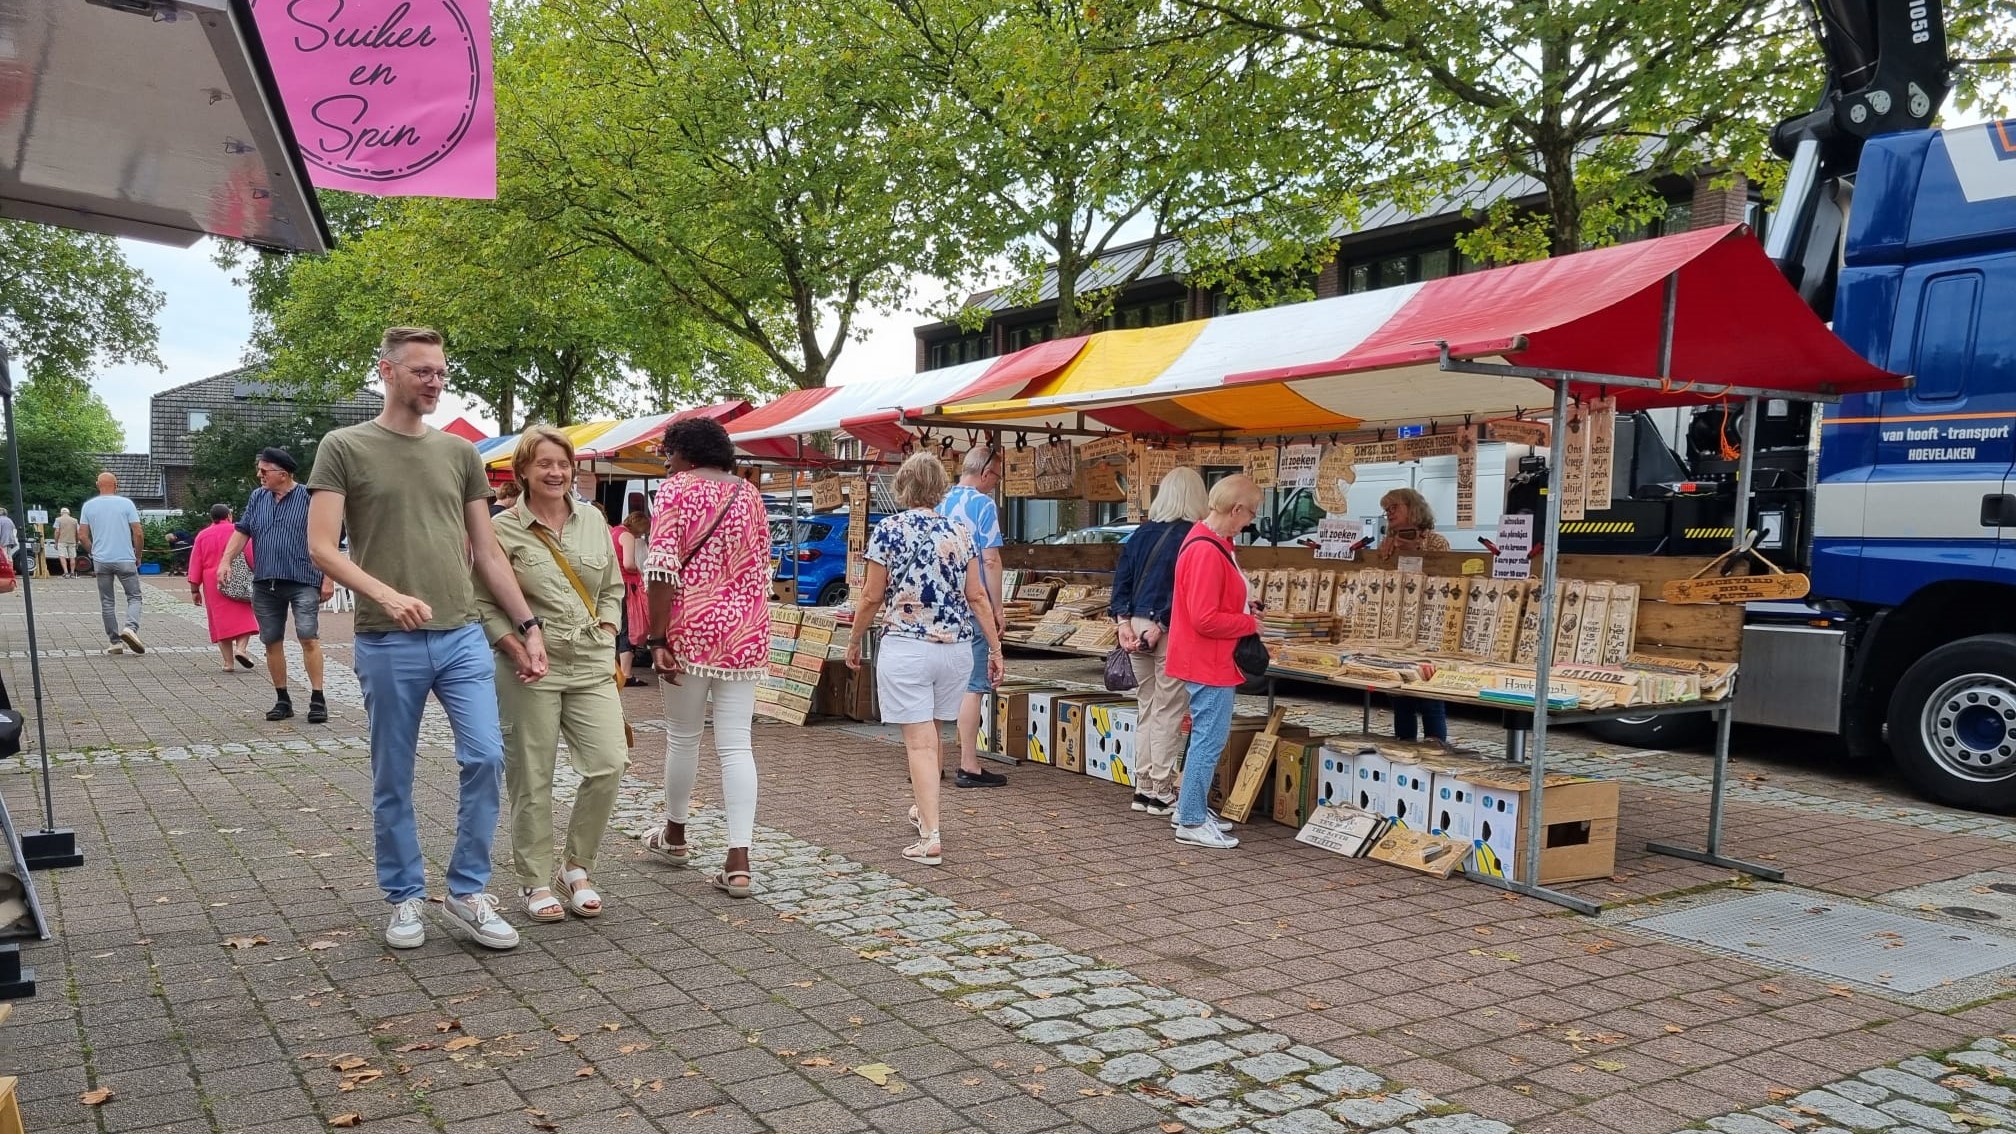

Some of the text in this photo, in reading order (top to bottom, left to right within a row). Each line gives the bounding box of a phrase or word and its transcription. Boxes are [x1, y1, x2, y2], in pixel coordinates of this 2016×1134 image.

[287, 0, 436, 52] Suiker
[349, 62, 397, 86] en
[311, 94, 420, 160] Spin
[1882, 430, 1904, 442] van
[1906, 427, 1939, 441] hooft
[1289, 454, 1316, 466] zoeken
[1907, 446, 1976, 461] HOEVELAKEN
[1329, 529, 1357, 540] zoeken
[1559, 668, 1625, 684] SALOON
[1505, 678, 1535, 690] Hawk
